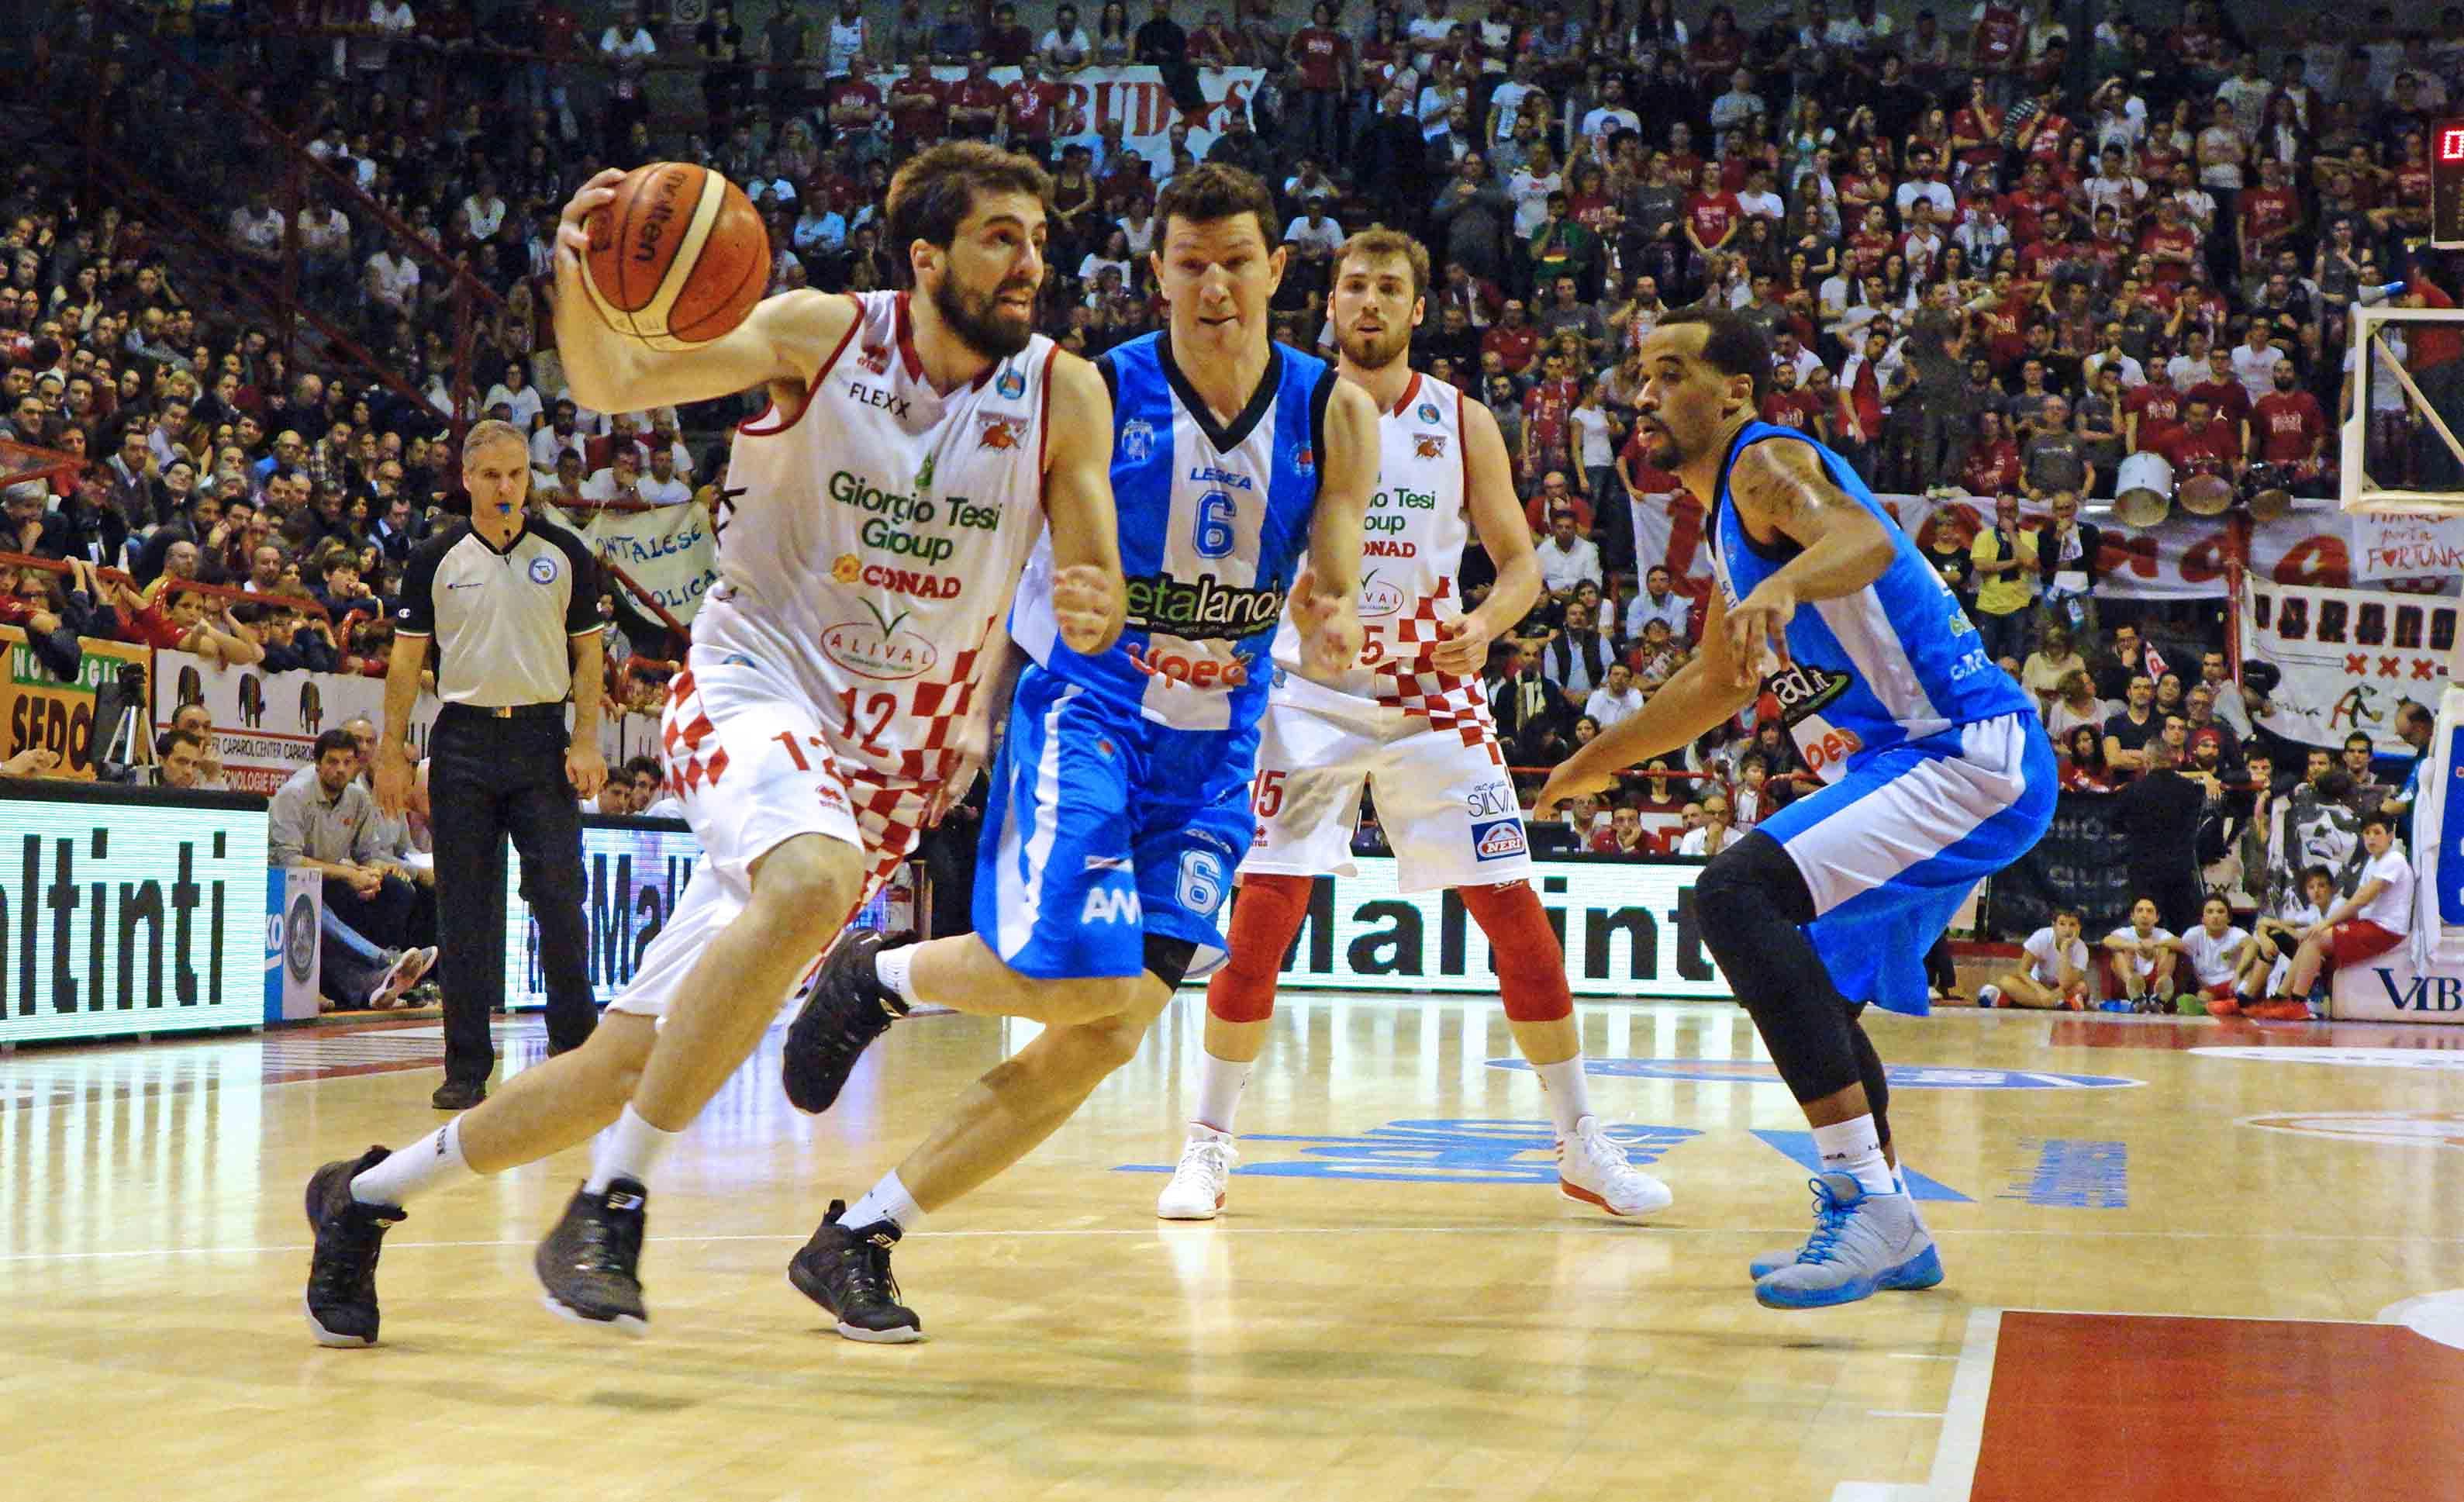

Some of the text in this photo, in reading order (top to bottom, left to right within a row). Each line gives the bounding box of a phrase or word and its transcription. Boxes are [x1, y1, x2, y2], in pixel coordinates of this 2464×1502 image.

[849, 382, 912, 420] FLEXX
[829, 470, 1003, 533] Giorgio Tesi
[1393, 488, 1436, 510] Tesi
[1192, 489, 1237, 559] 6
[1364, 515, 1406, 535] oup
[862, 564, 962, 599] CONAD
[830, 633, 930, 665] ALIVAL
[1360, 625, 1385, 665] 5
[838, 687, 898, 758] 12
[1486, 838, 1520, 853] NERI
[1175, 850, 1223, 917] 6
